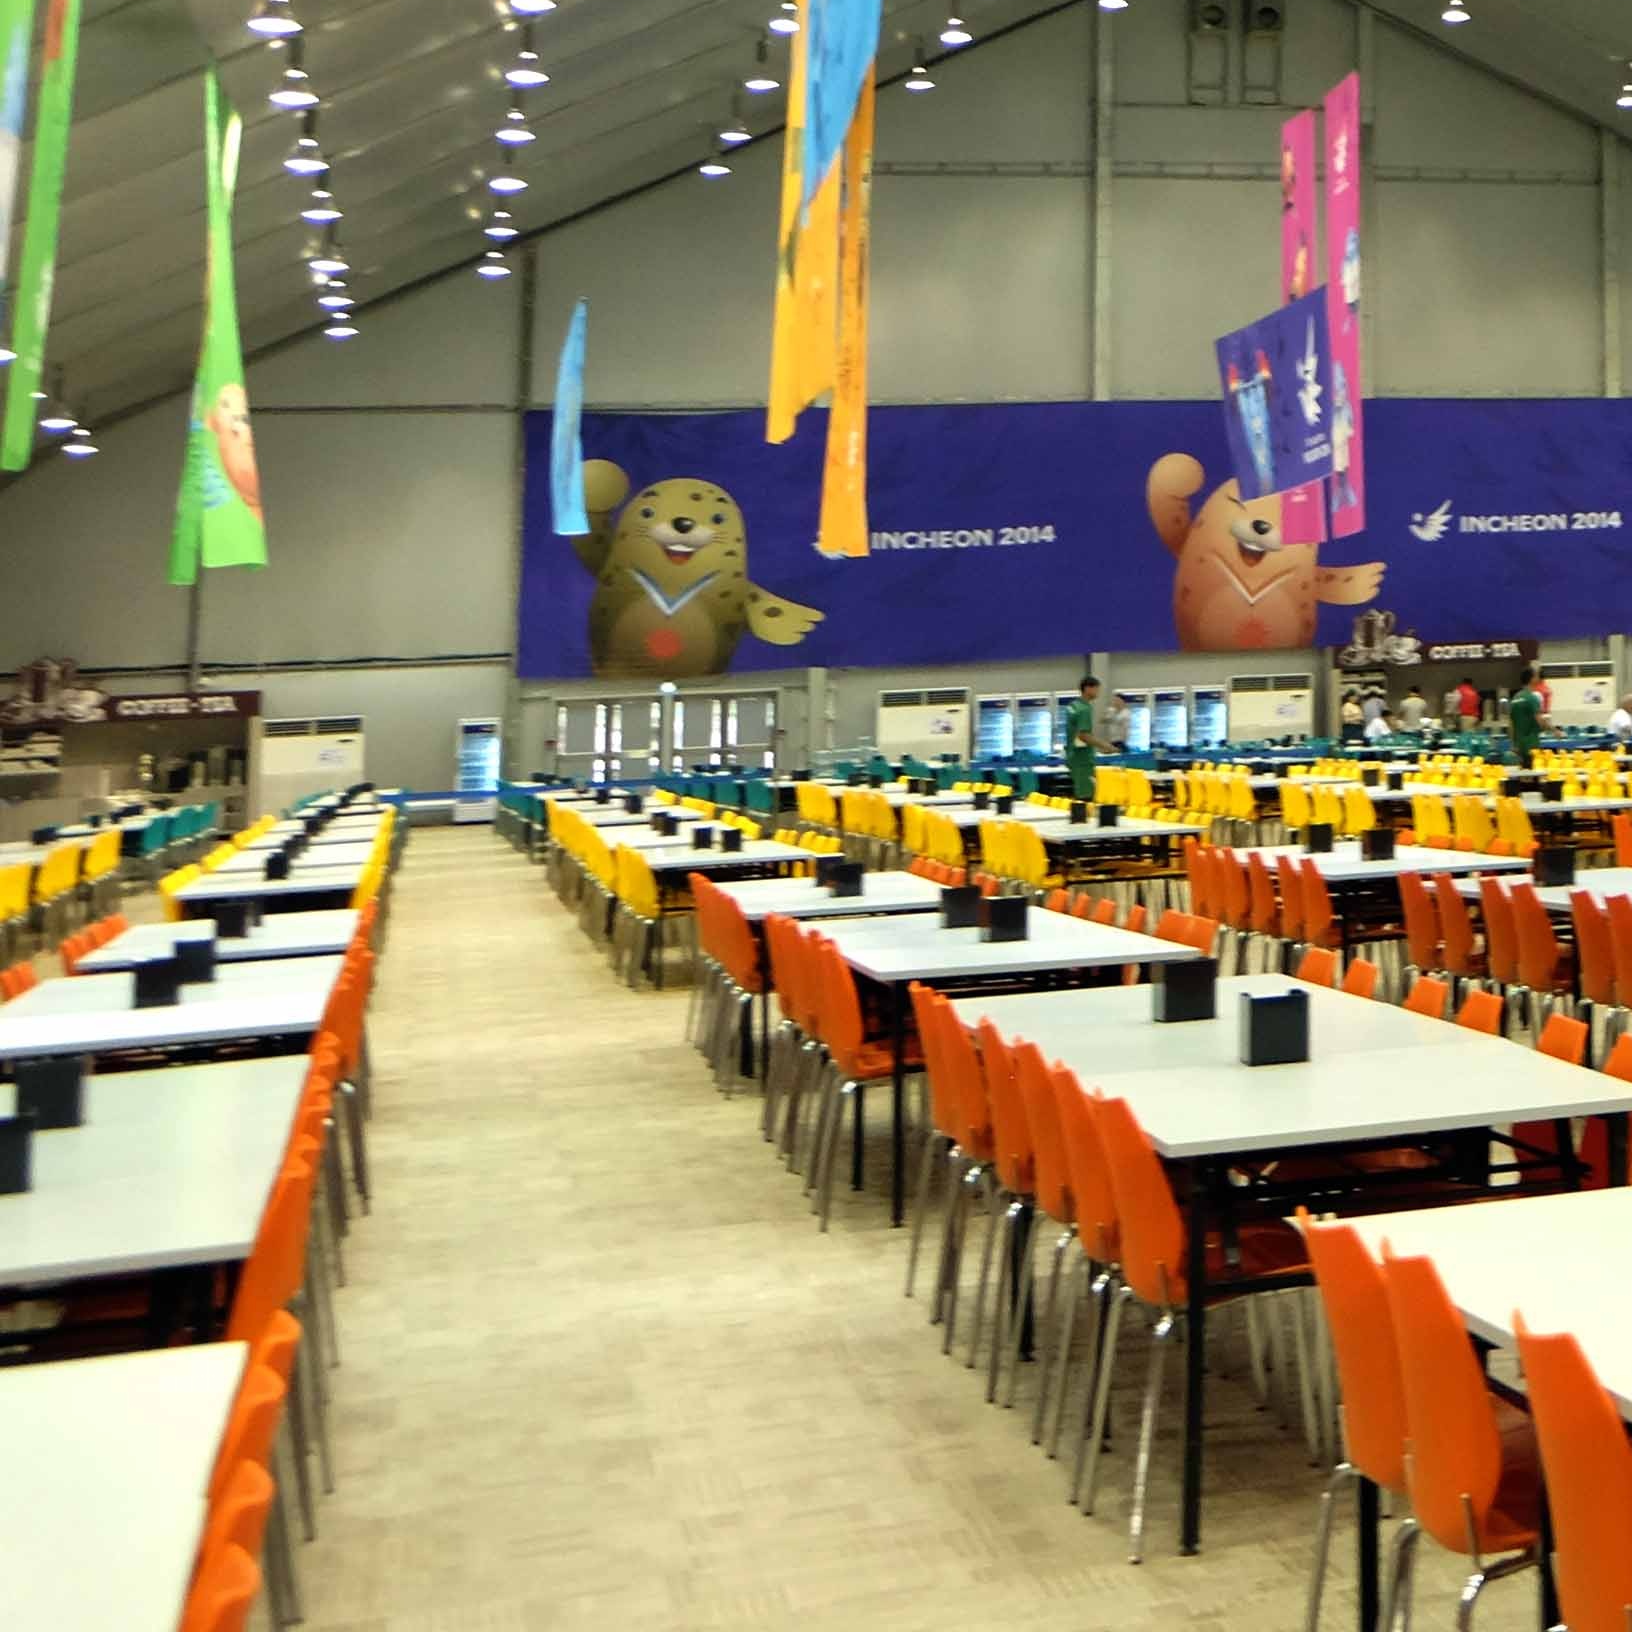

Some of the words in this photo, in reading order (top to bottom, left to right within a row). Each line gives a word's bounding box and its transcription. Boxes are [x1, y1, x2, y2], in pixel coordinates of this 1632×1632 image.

[1459, 513, 1567, 533] INCHEON
[1570, 510, 1622, 530] 2014
[871, 529, 993, 550] INCHEON
[999, 525, 1056, 546] 2014
